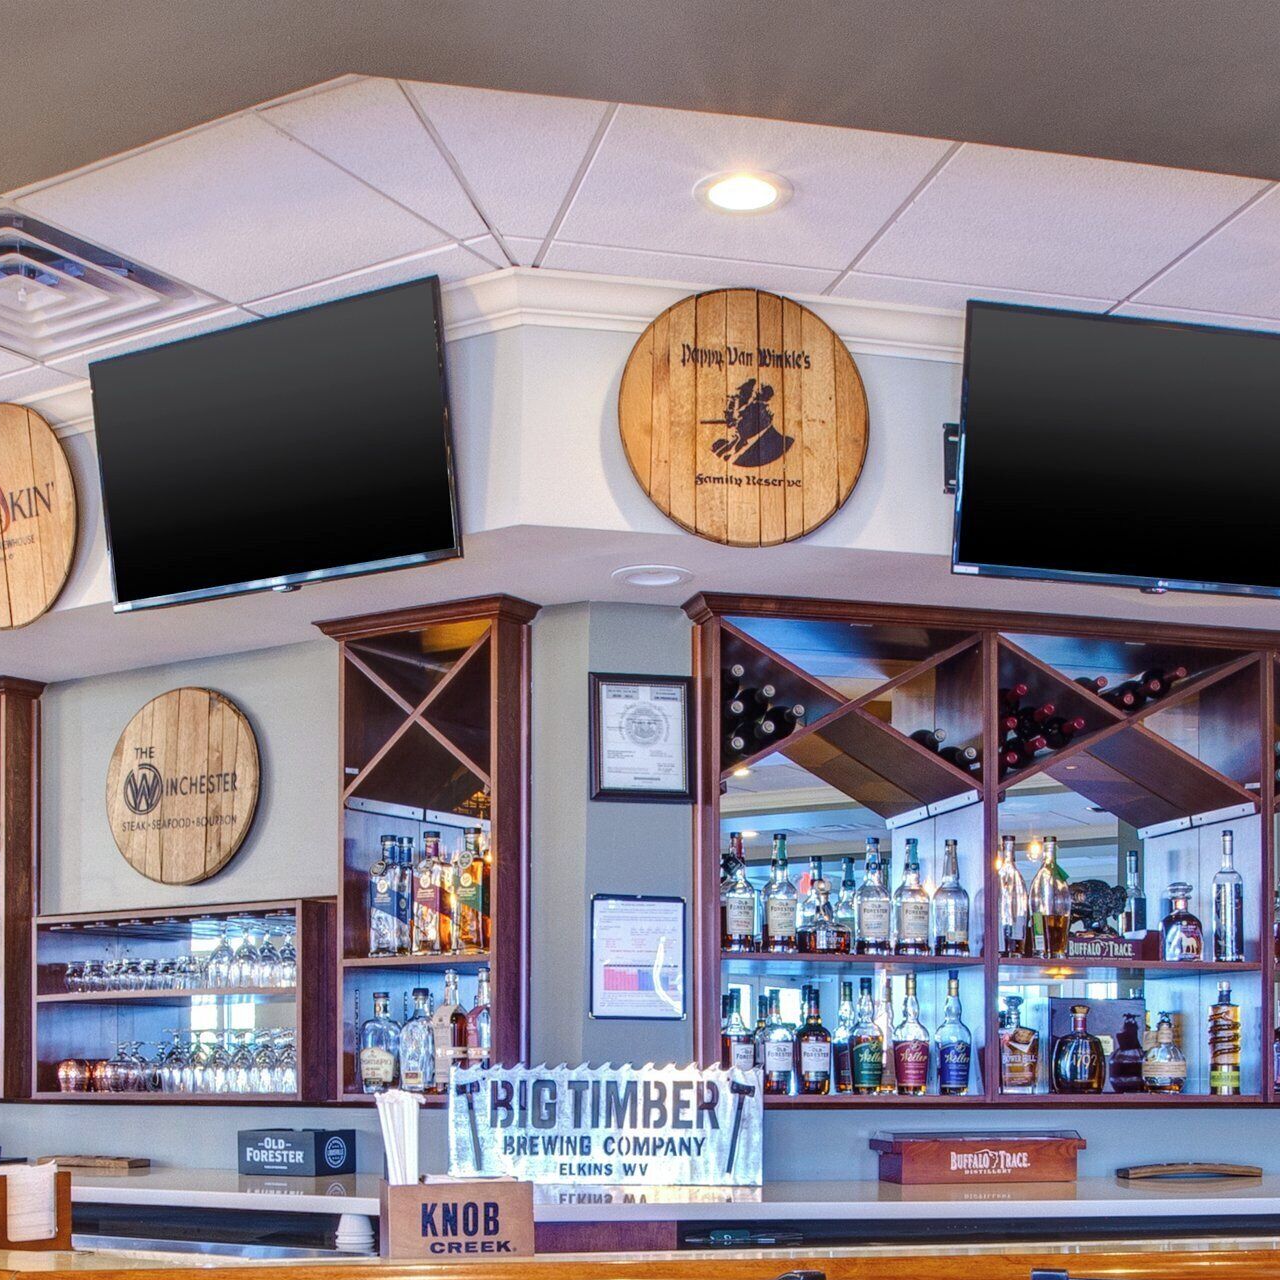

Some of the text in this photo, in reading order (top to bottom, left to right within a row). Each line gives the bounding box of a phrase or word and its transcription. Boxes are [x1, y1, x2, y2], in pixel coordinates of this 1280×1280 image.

[726, 347, 753, 366] Van
[758, 347, 811, 370] Winkle's
[694, 473, 802, 488] Family Reserve
[134, 747, 155, 759] THE
[122, 814, 237, 832] STEAK SEAFOOD BOURBON
[1068, 941, 1101, 956] BUFFALO
[491, 1080, 720, 1130] BIG TIMBER
[264, 1137, 285, 1149] OLD
[504, 1135, 706, 1157] BREWING COMPANY
[246, 1147, 304, 1163] FORESTER
[950, 1150, 1030, 1171] BUFFALO TRACE
[559, 1162, 649, 1177] ELKINS WV
[421, 1202, 500, 1237] KNOB
[430, 1241, 511, 1254] CREEK
